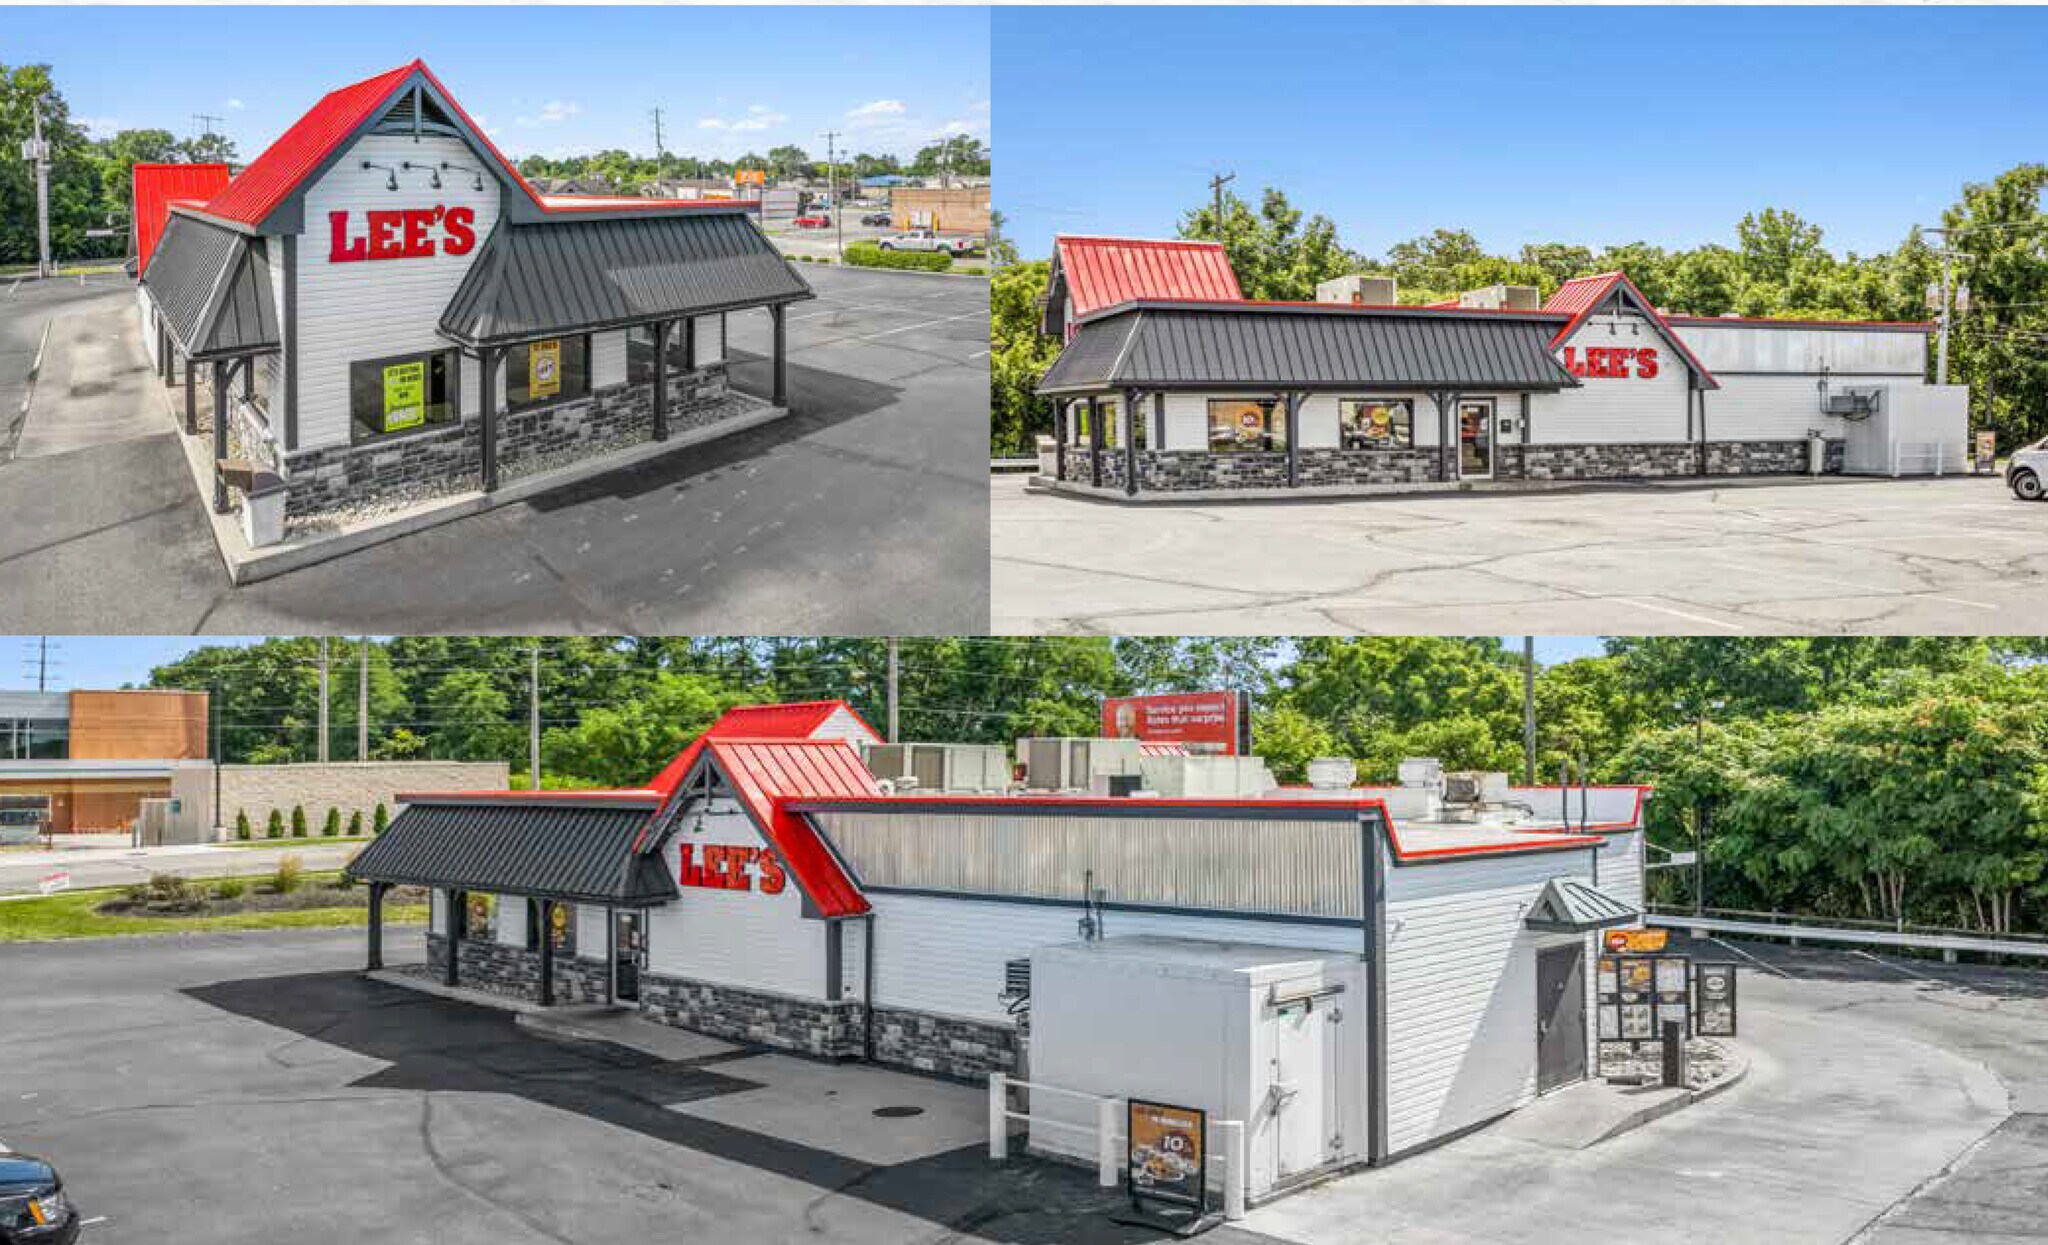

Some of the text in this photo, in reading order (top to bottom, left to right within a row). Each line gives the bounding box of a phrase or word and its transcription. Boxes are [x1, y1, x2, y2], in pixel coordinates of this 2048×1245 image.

[329, 205, 476, 263] LEE'S
[1564, 347, 1658, 378] LEE'S
[680, 844, 786, 894] LEE'S
